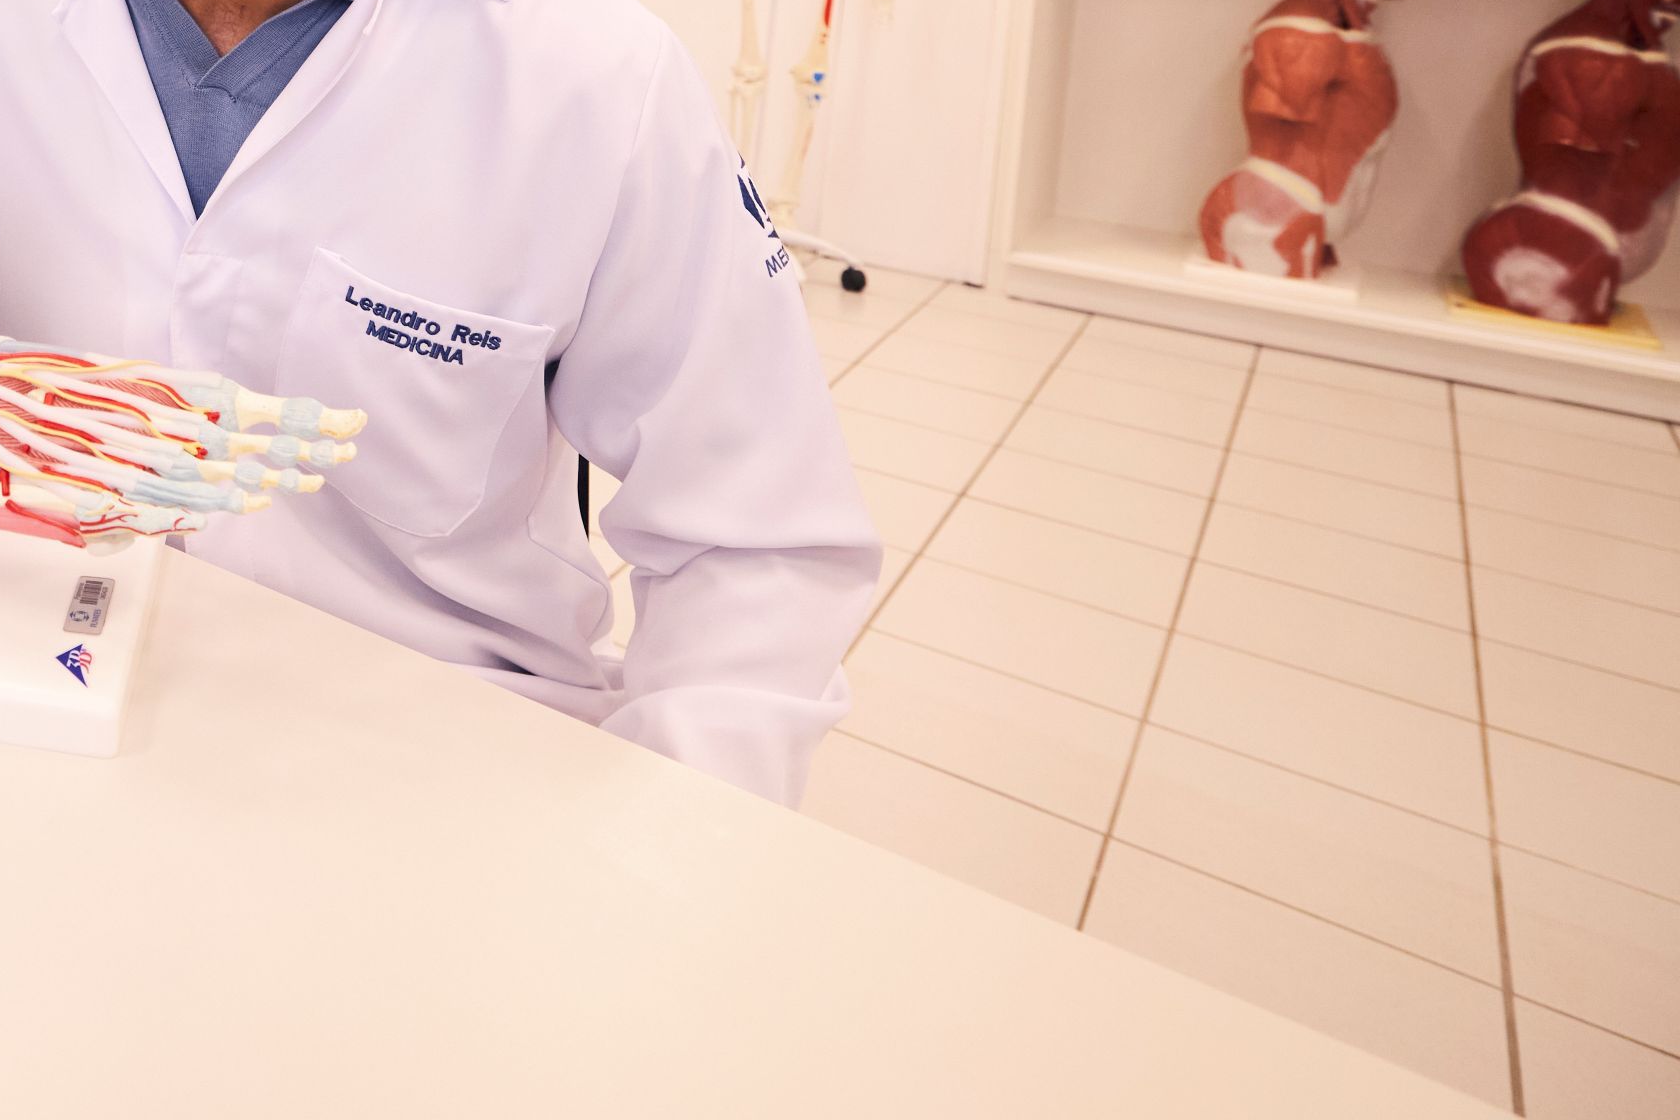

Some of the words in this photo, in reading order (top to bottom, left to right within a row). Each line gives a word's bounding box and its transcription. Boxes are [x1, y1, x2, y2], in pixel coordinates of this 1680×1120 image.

[345, 285, 441, 336] Leandro
[450, 323, 502, 351] Reis
[365, 319, 464, 365] MEDICINA
